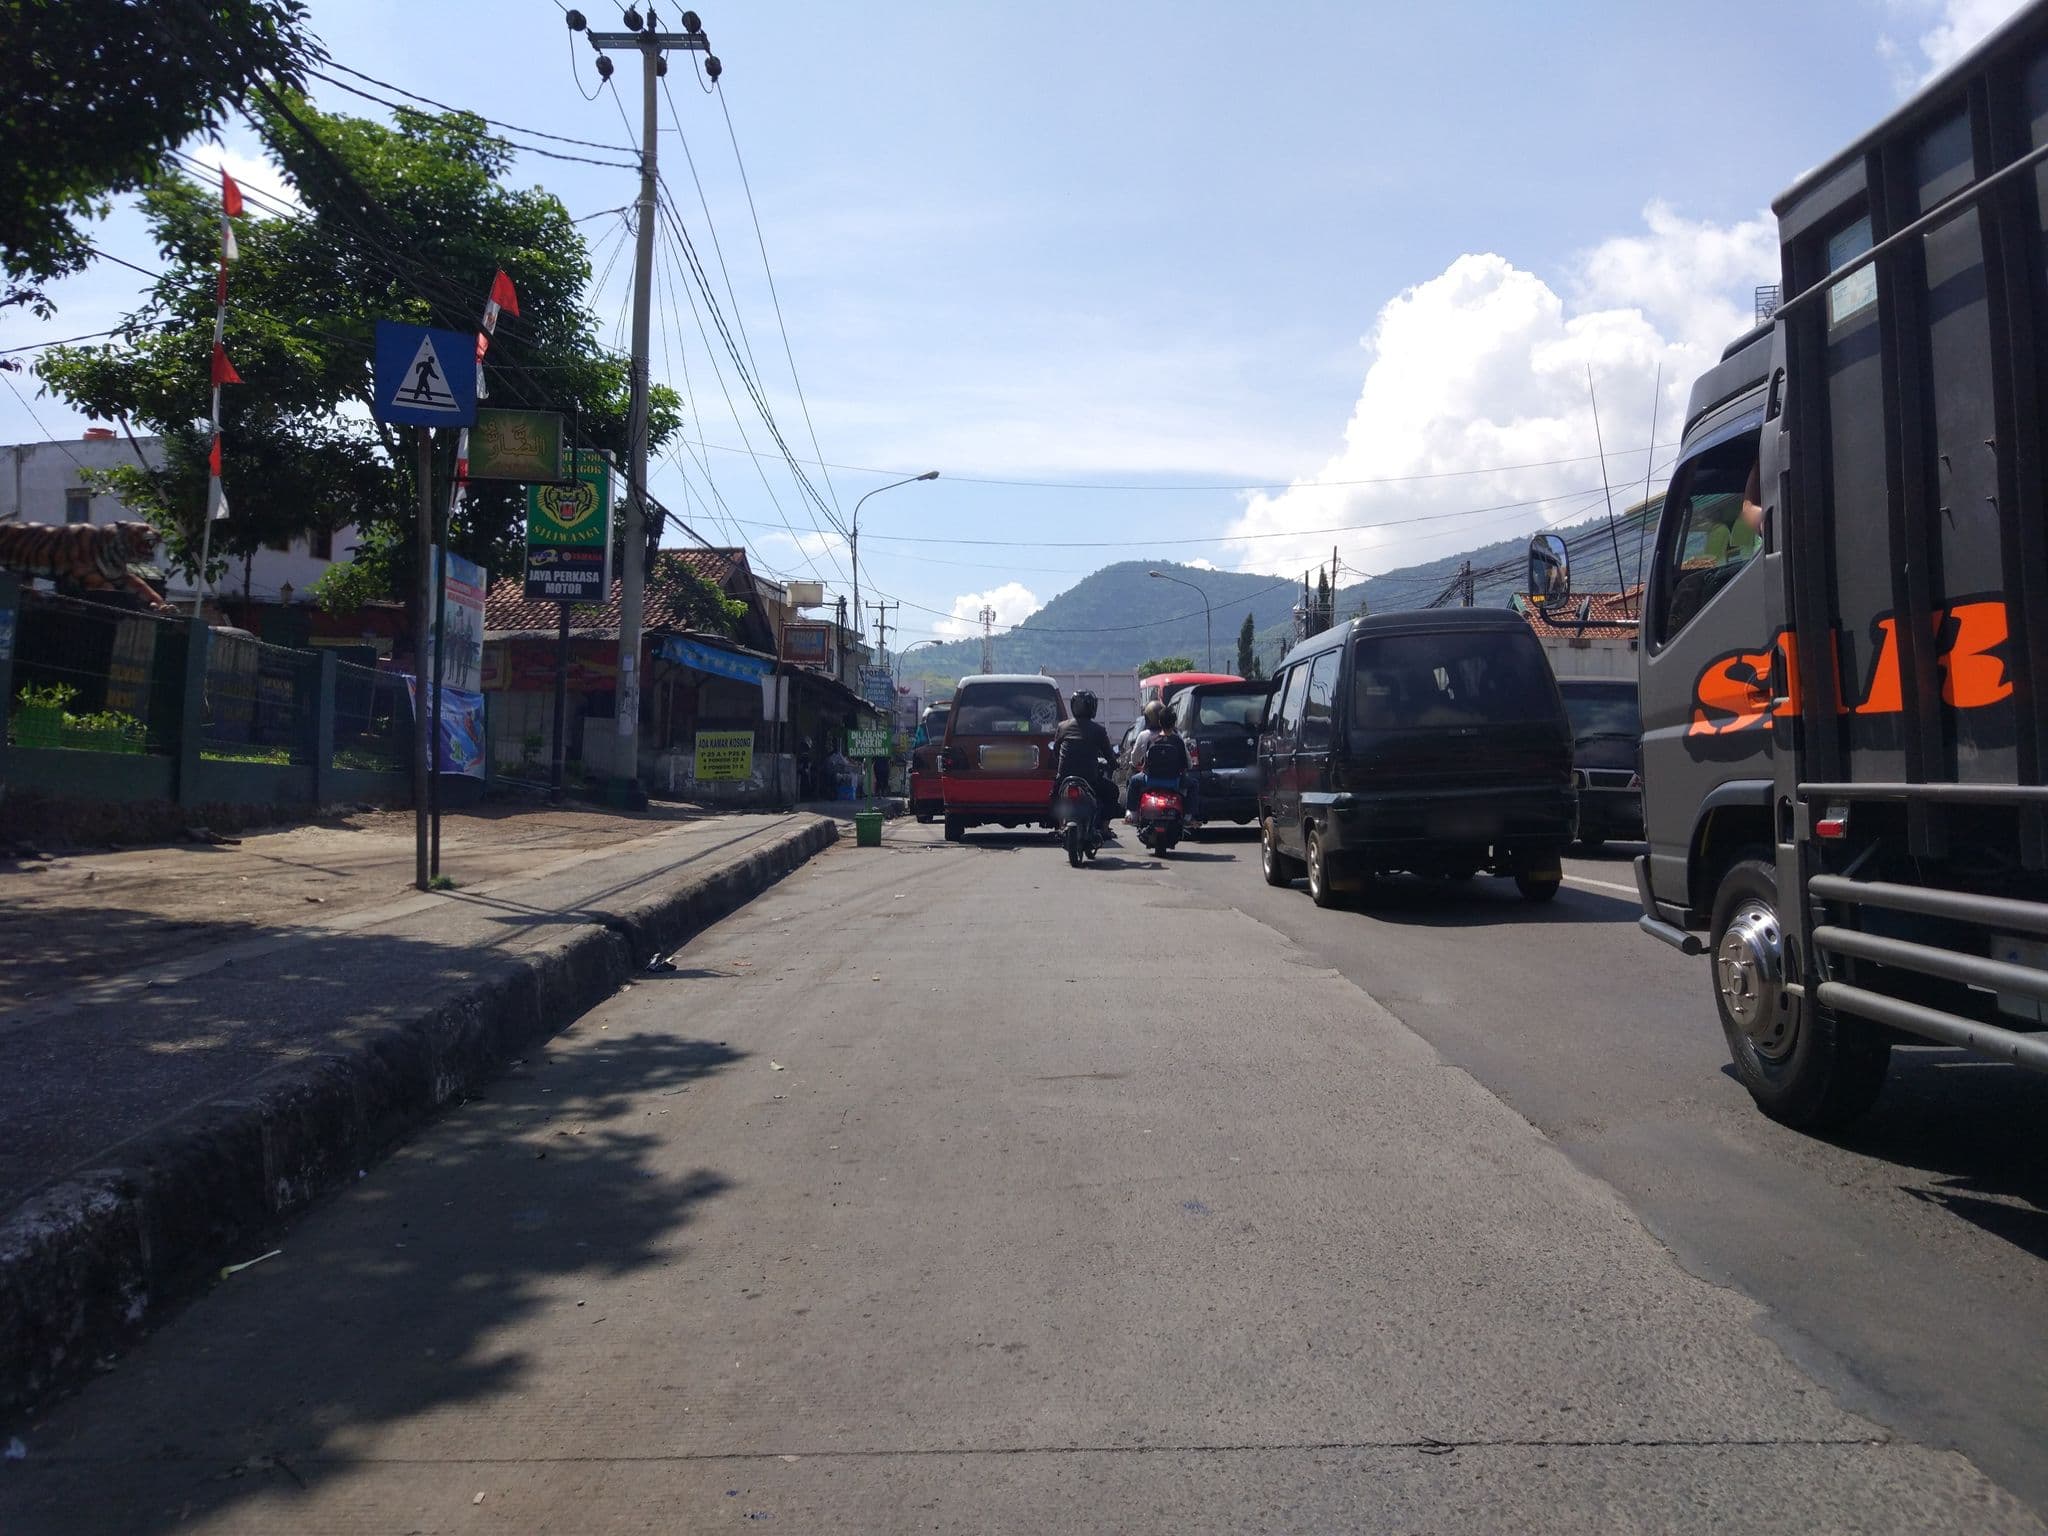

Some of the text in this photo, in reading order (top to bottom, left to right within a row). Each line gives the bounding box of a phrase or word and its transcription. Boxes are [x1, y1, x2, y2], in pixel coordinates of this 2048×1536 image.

[532, 524, 600, 543] SILIWANGI
[529, 570, 600, 583] JAYA PERKASA
[545, 582, 582, 595] MOTOR
[729, 737, 751, 748] KOSONG
[855, 738, 883, 748] PARKIR
